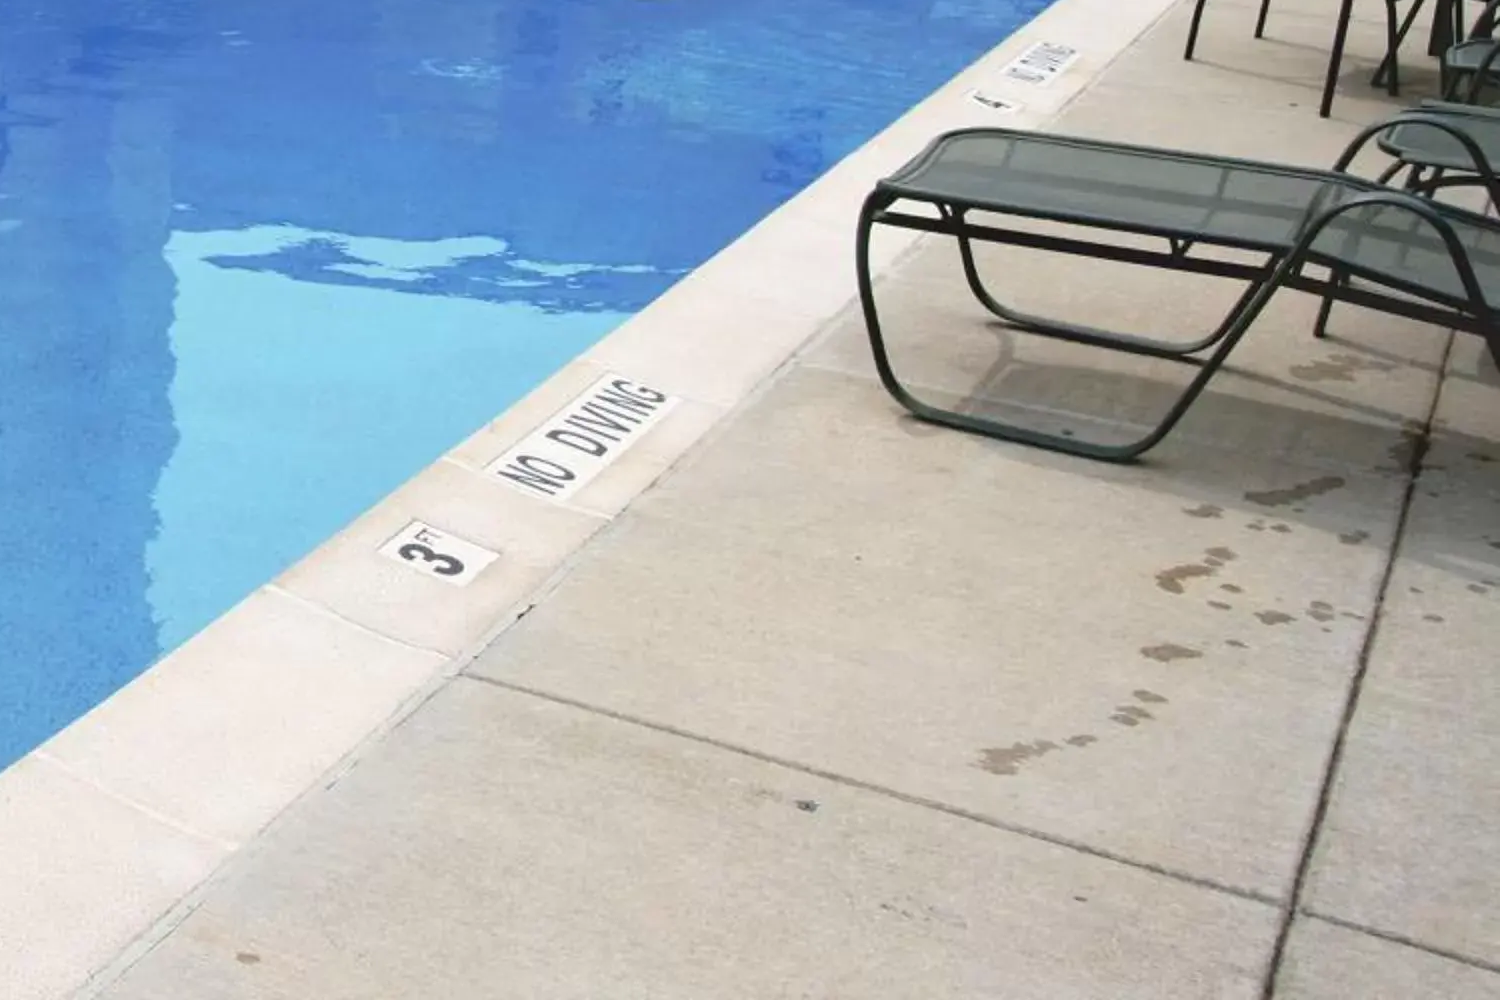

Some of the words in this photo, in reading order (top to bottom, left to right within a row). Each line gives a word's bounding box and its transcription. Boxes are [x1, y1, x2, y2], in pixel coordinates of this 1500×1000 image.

[498, 454, 577, 496] NO
[545, 378, 667, 458] DIVING
[398, 543, 465, 577] 3
